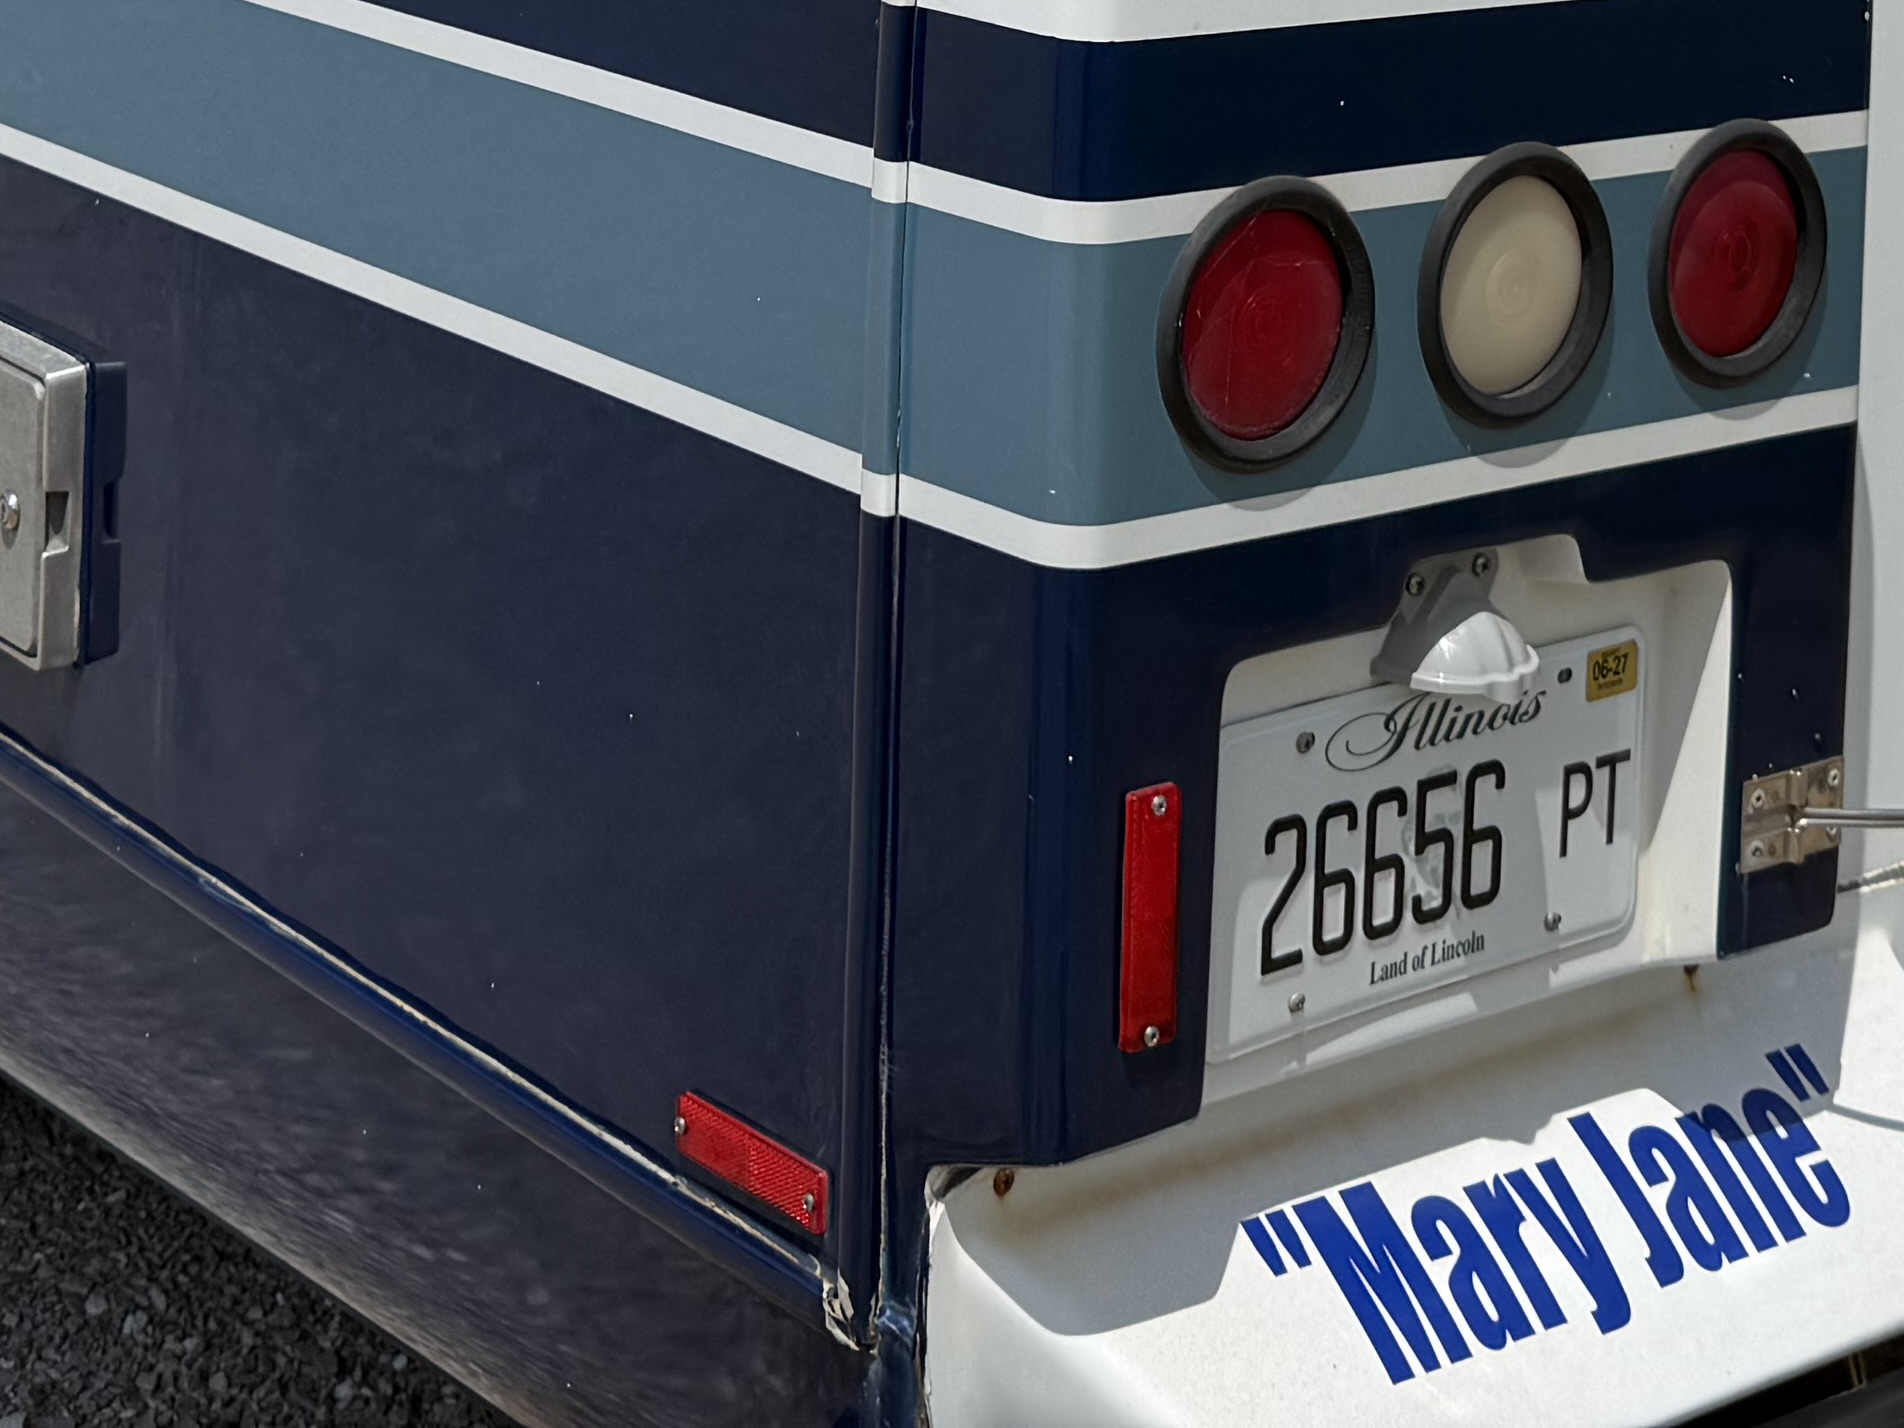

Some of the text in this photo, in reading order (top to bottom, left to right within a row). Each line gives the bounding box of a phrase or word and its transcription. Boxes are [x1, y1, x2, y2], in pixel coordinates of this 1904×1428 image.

[1593, 652, 1628, 681] 06-27
[1324, 689, 1547, 772] Illinois
[1260, 748, 1632, 977] 26656 PT
[1369, 930, 1485, 986] Land of Lincoln
[1240, 1043, 1851, 1385] "Mary Jane"
